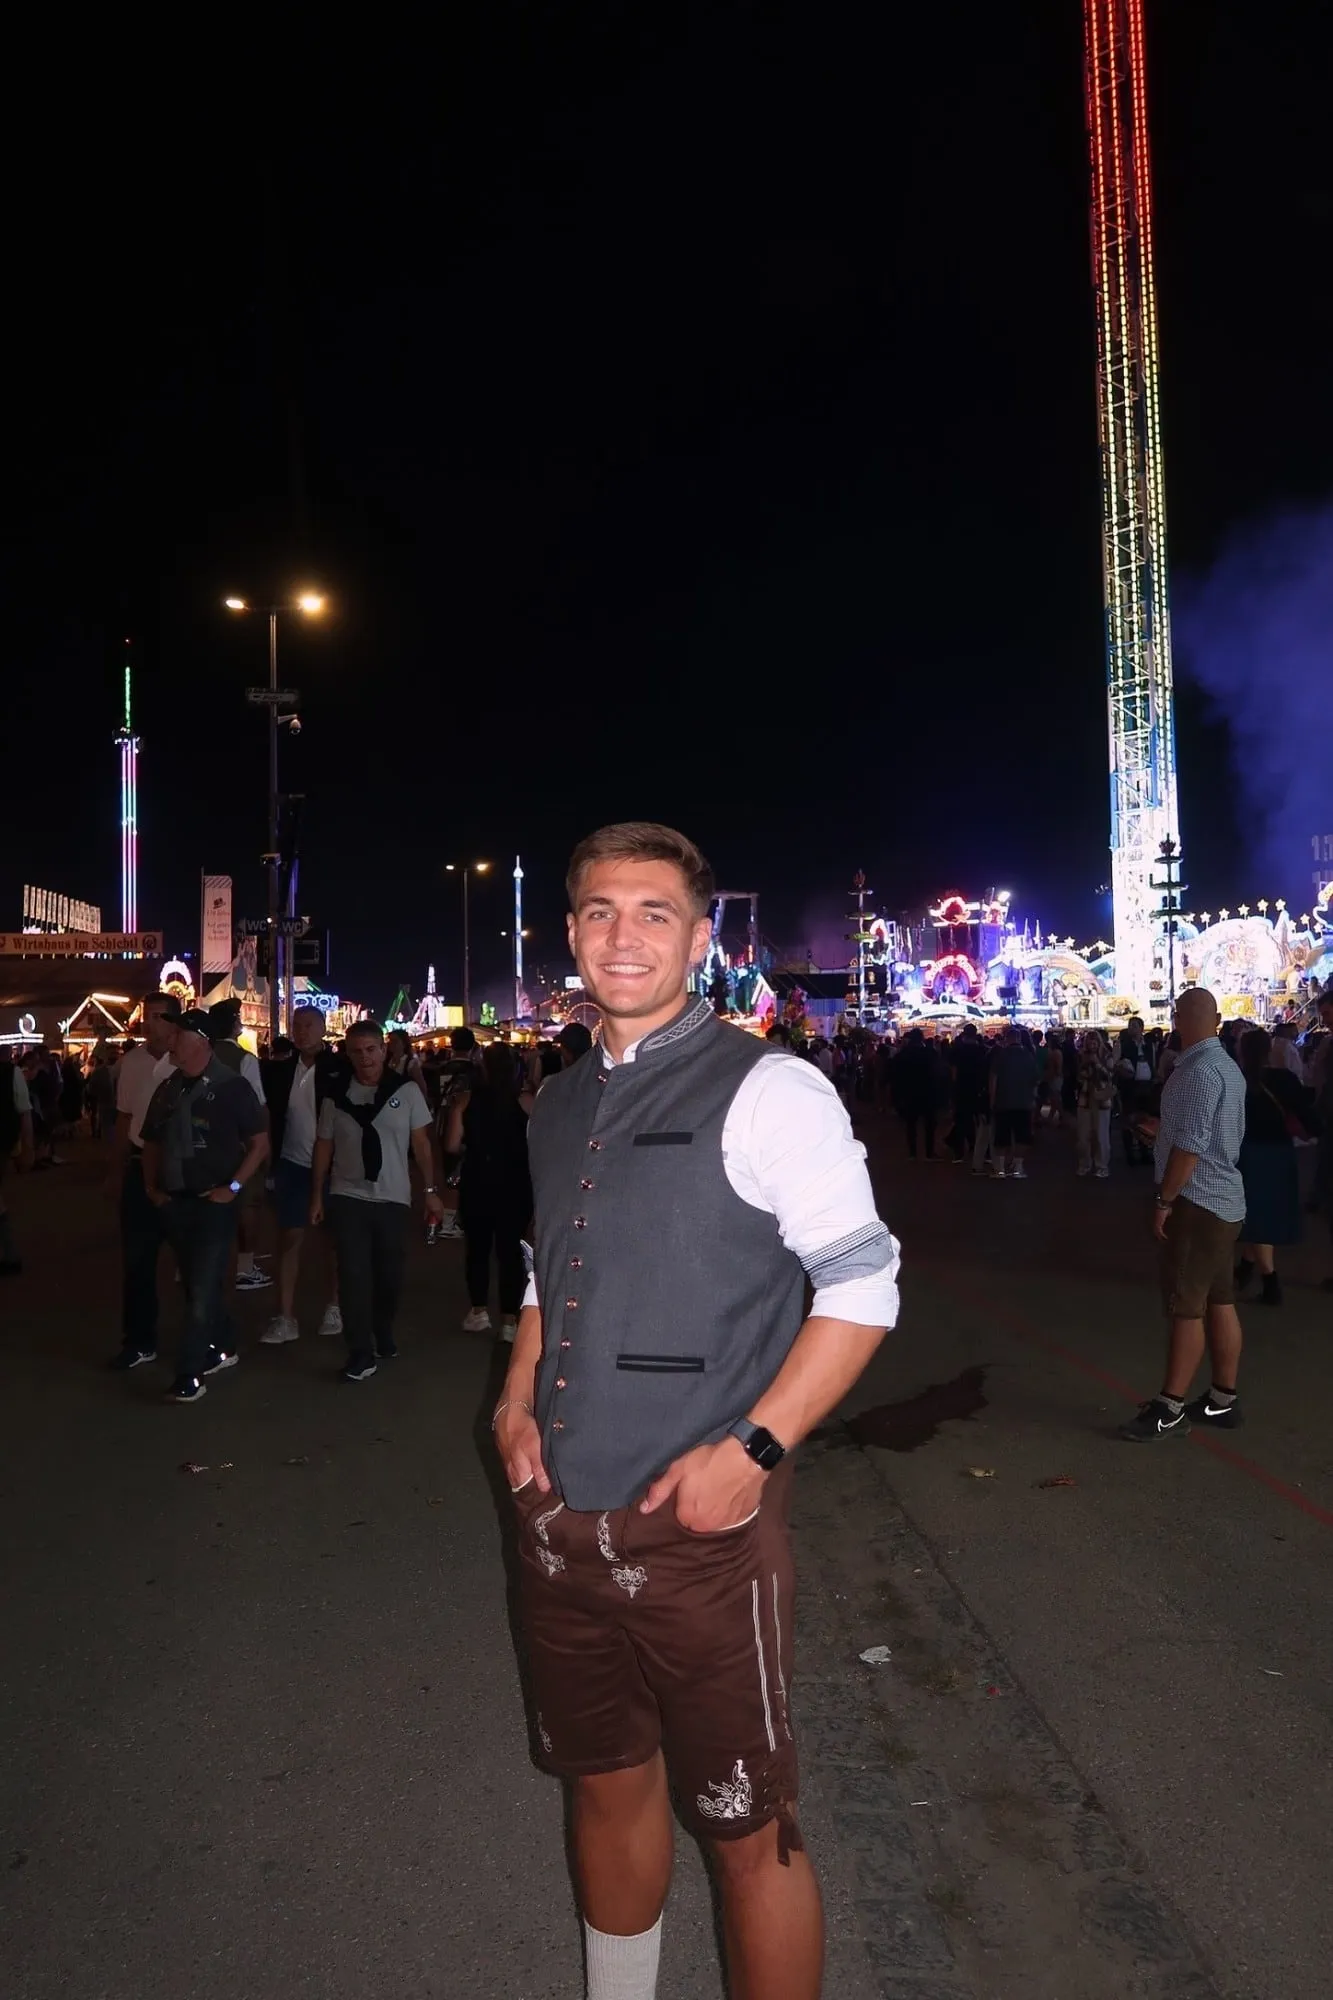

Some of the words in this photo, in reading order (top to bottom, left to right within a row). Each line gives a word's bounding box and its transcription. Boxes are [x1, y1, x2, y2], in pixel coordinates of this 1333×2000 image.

[247, 920, 267, 931] WC
[282, 921, 301, 932] WC
[13, 938, 71, 950] Wirtshaus
